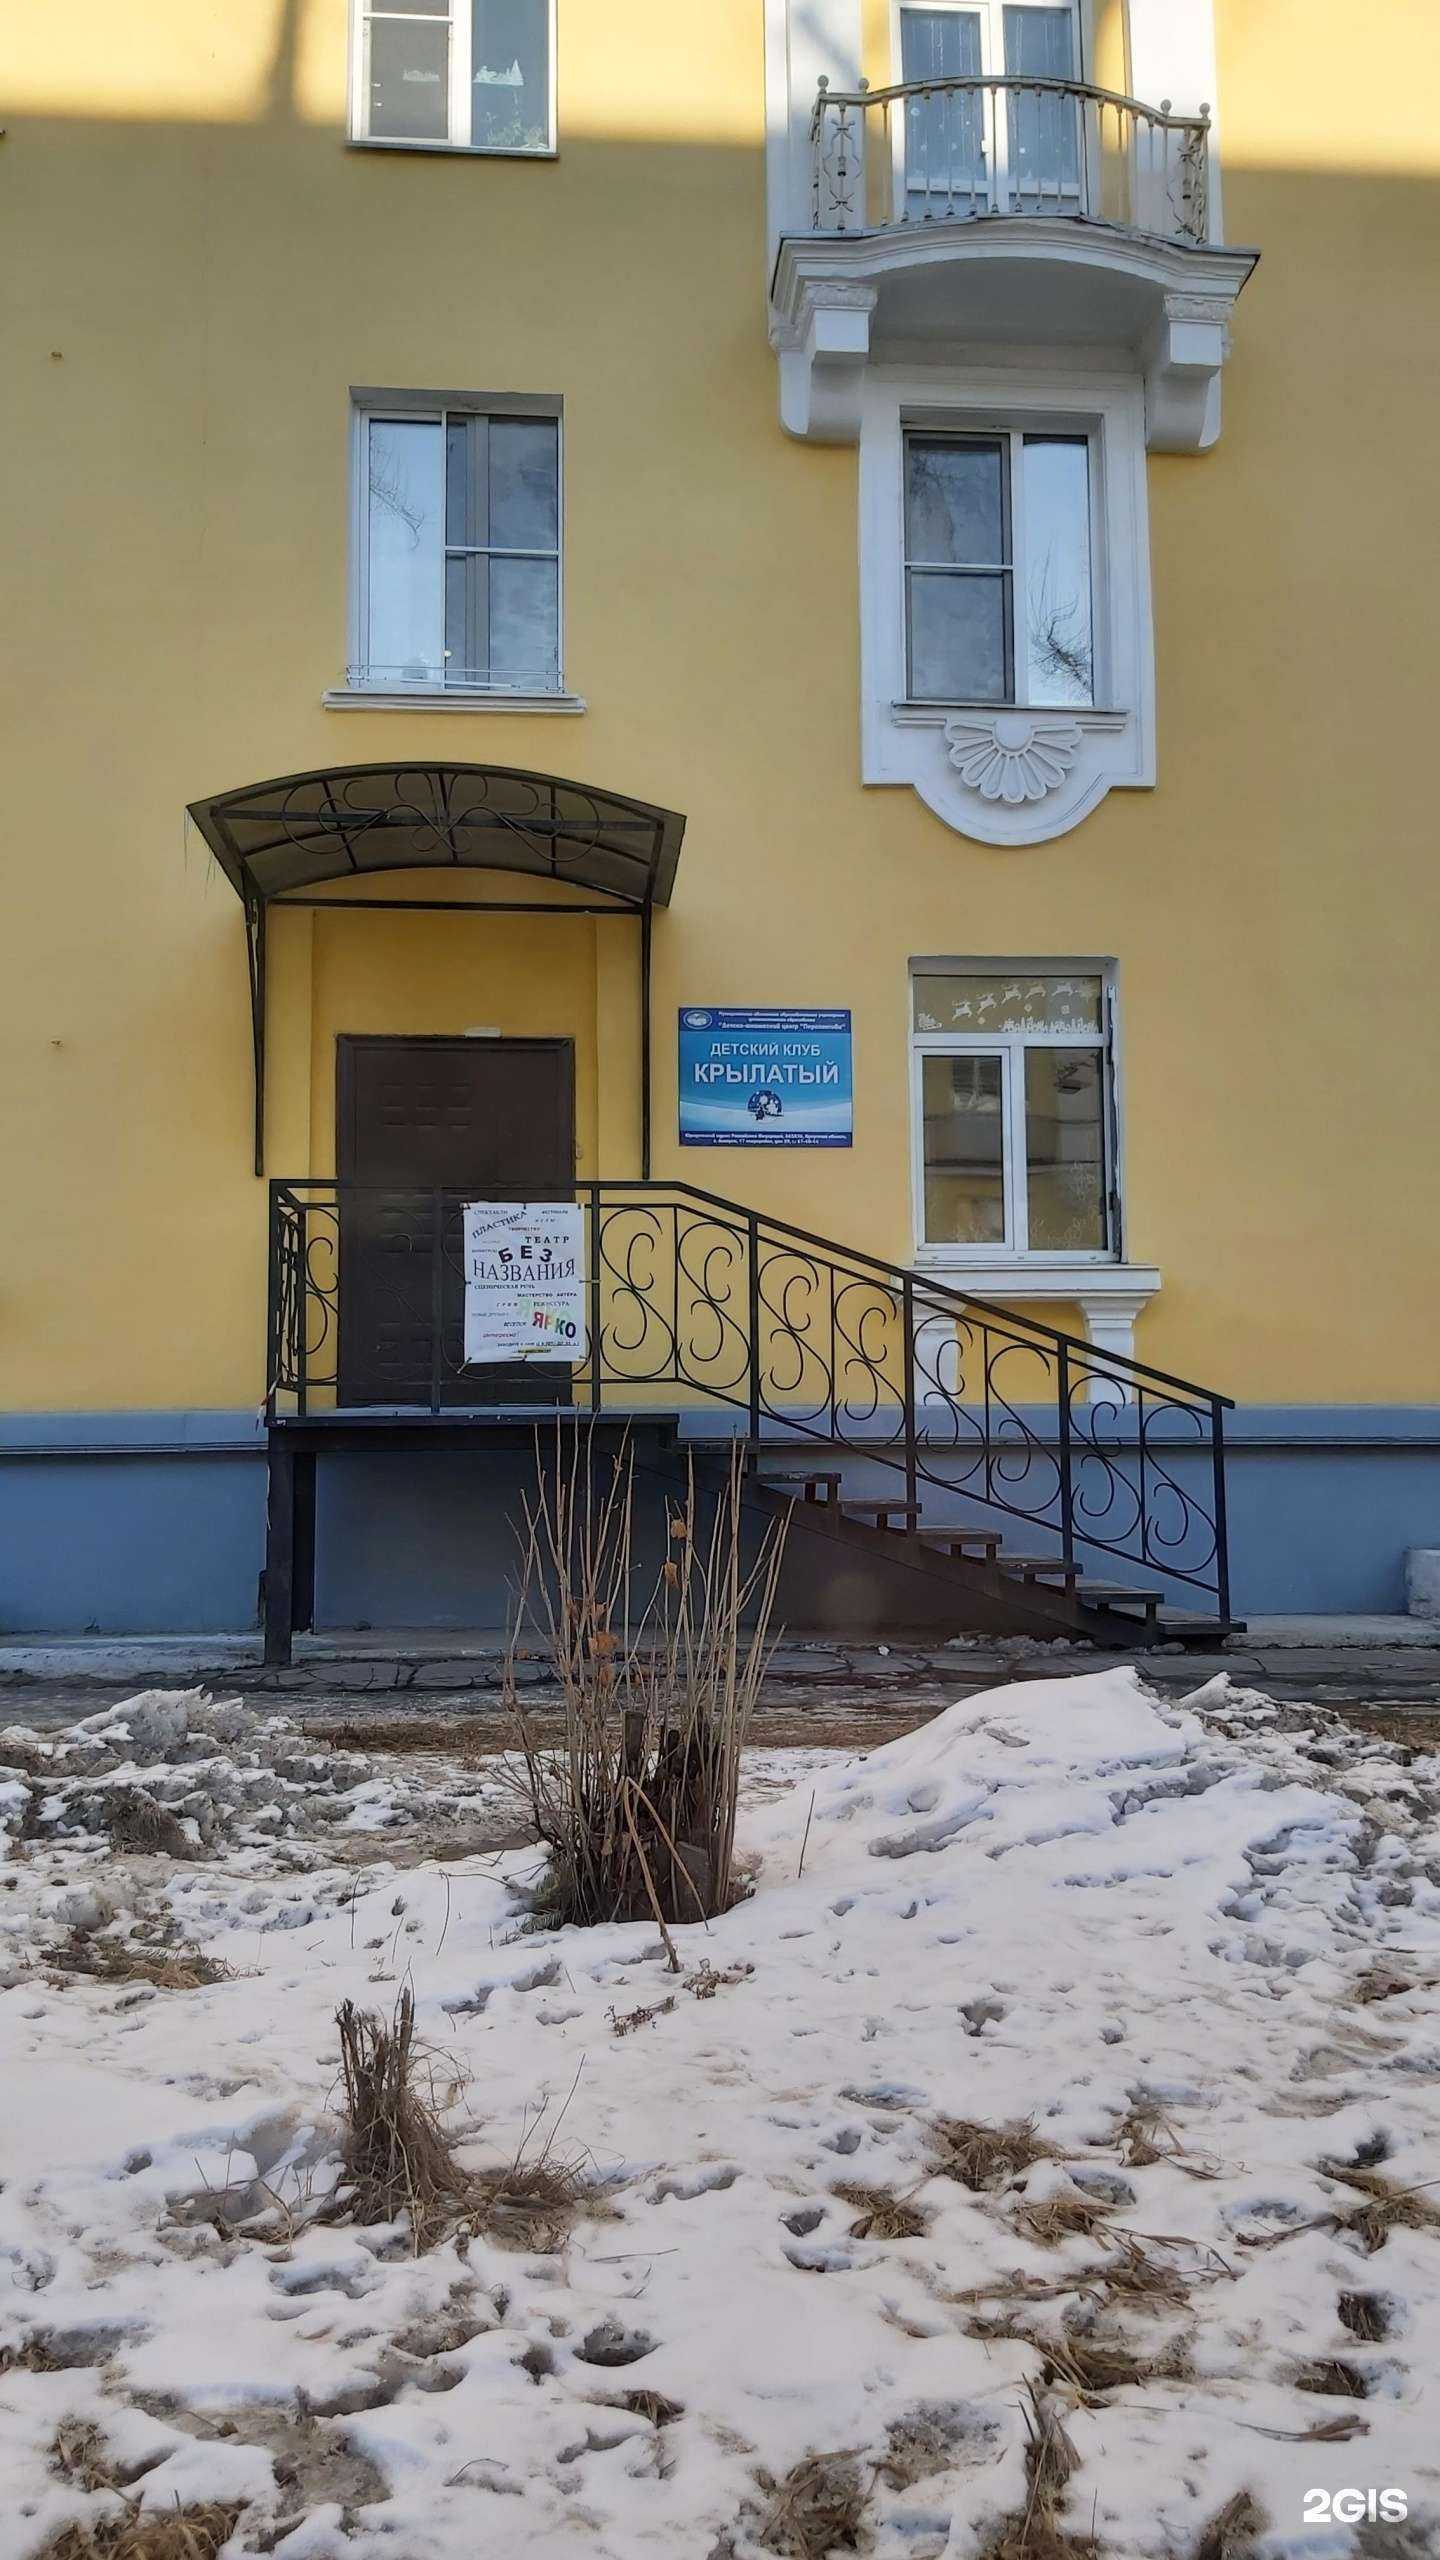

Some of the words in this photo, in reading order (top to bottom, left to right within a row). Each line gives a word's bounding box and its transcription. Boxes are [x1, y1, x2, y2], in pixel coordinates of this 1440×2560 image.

[710, 1041, 779, 1057] ДЕТСКИЙ
[783, 1044, 821, 1057] КЛУБ
[694, 1060, 839, 1084] КРЫЛАТЫЙ
[471, 1210, 527, 1240] ПЛАСТИКА
[524, 1236, 570, 1244] ТЕАТР
[498, 1245, 553, 1263] БЕЗ
[473, 1258, 576, 1281] НАЗВАНИЯ
[532, 1311, 577, 1339] ЯРКО
